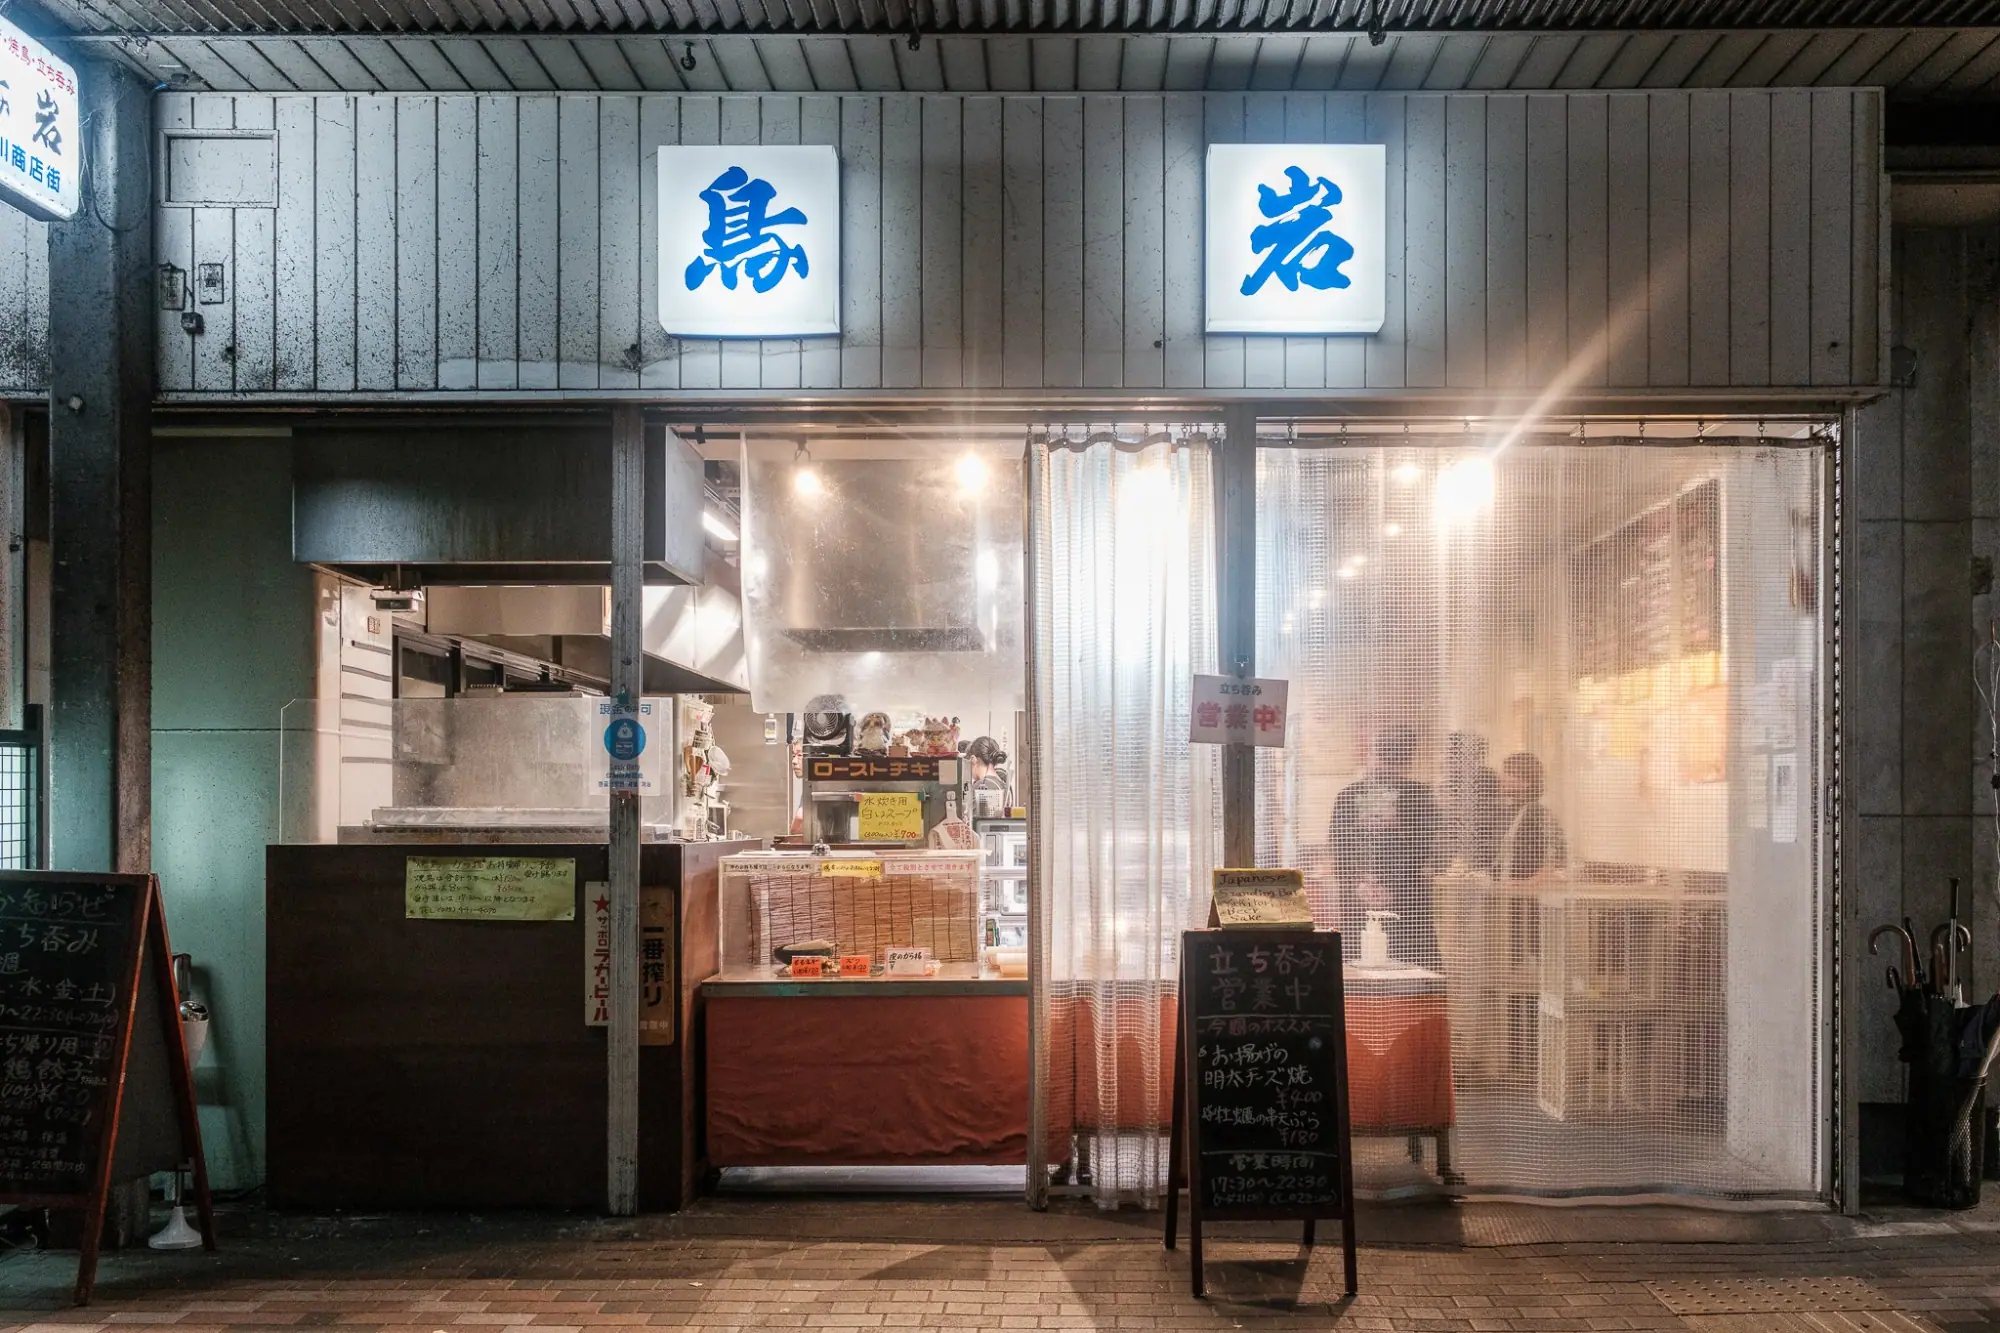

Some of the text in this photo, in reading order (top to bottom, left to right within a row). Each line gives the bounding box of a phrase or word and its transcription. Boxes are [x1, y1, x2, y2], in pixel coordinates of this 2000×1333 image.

[684, 166, 1354, 295] 鳥 岩
[1219, 684, 1262, 696] 立ち呑み
[1197, 701, 1277, 731] 営業中
[862, 807, 918, 820] 白いスープ
[864, 797, 907, 806] 水炊き用
[1219, 873, 1286, 886] Japanese
[0, 922, 98, 955] ち呑み
[643, 926, 664, 1007] 一番搾り
[1209, 944, 1325, 975] 立ち呑み
[0, 977, 117, 1008] ・水・金・土)
[1212, 976, 1312, 1011] 営業中
[0, 1033, 78, 1056] ち帰り用
[1204, 1064, 1313, 1090] 明太チーズ焼
[1279, 1127, 1318, 1146] ¥180
[1229, 1153, 1314, 1171] 営業時間
